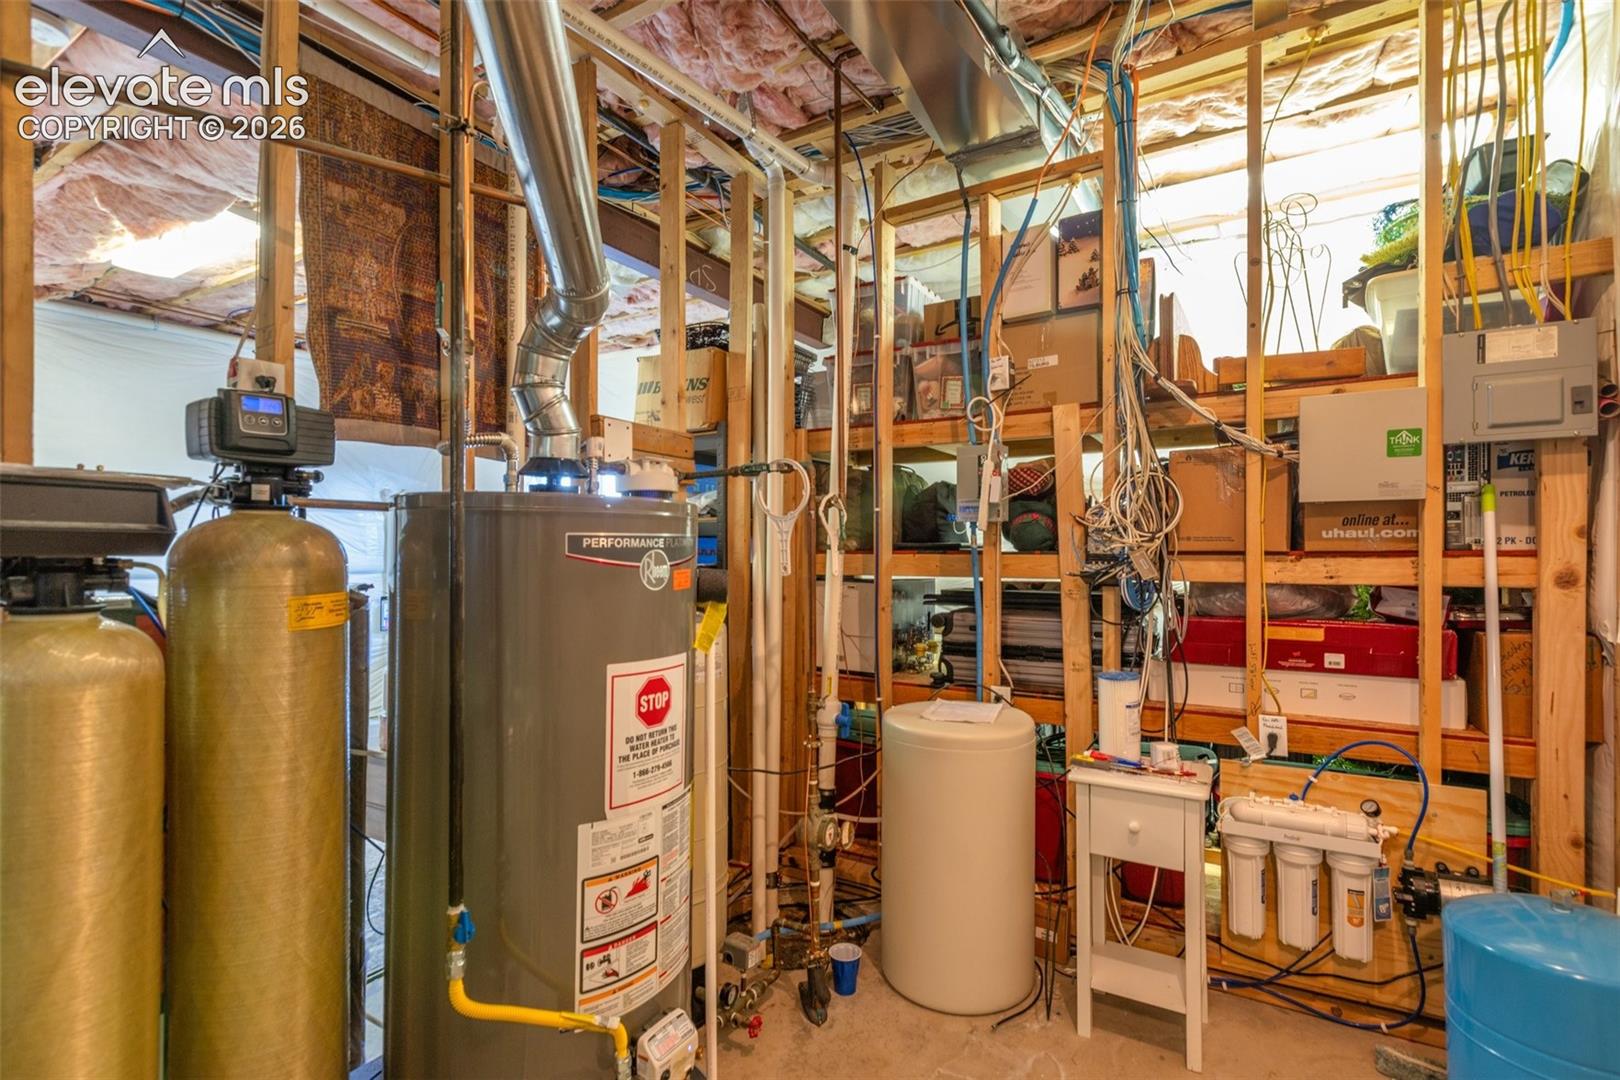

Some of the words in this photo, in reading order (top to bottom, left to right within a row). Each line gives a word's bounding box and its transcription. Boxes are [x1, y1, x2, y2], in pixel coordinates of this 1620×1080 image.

[1342, 513, 1380, 527] online
[582, 537, 664, 548] PERFORMANCE
[640, 690, 669, 713] STOP
[625, 736, 635, 745] DO
[636, 733, 647, 742] NOT
[648, 727, 668, 740] RETURN
[629, 741, 650, 753] WATER
[618, 754, 630, 764] THE
[632, 750, 650, 761] PLACE
[652, 747, 659, 756] OF
